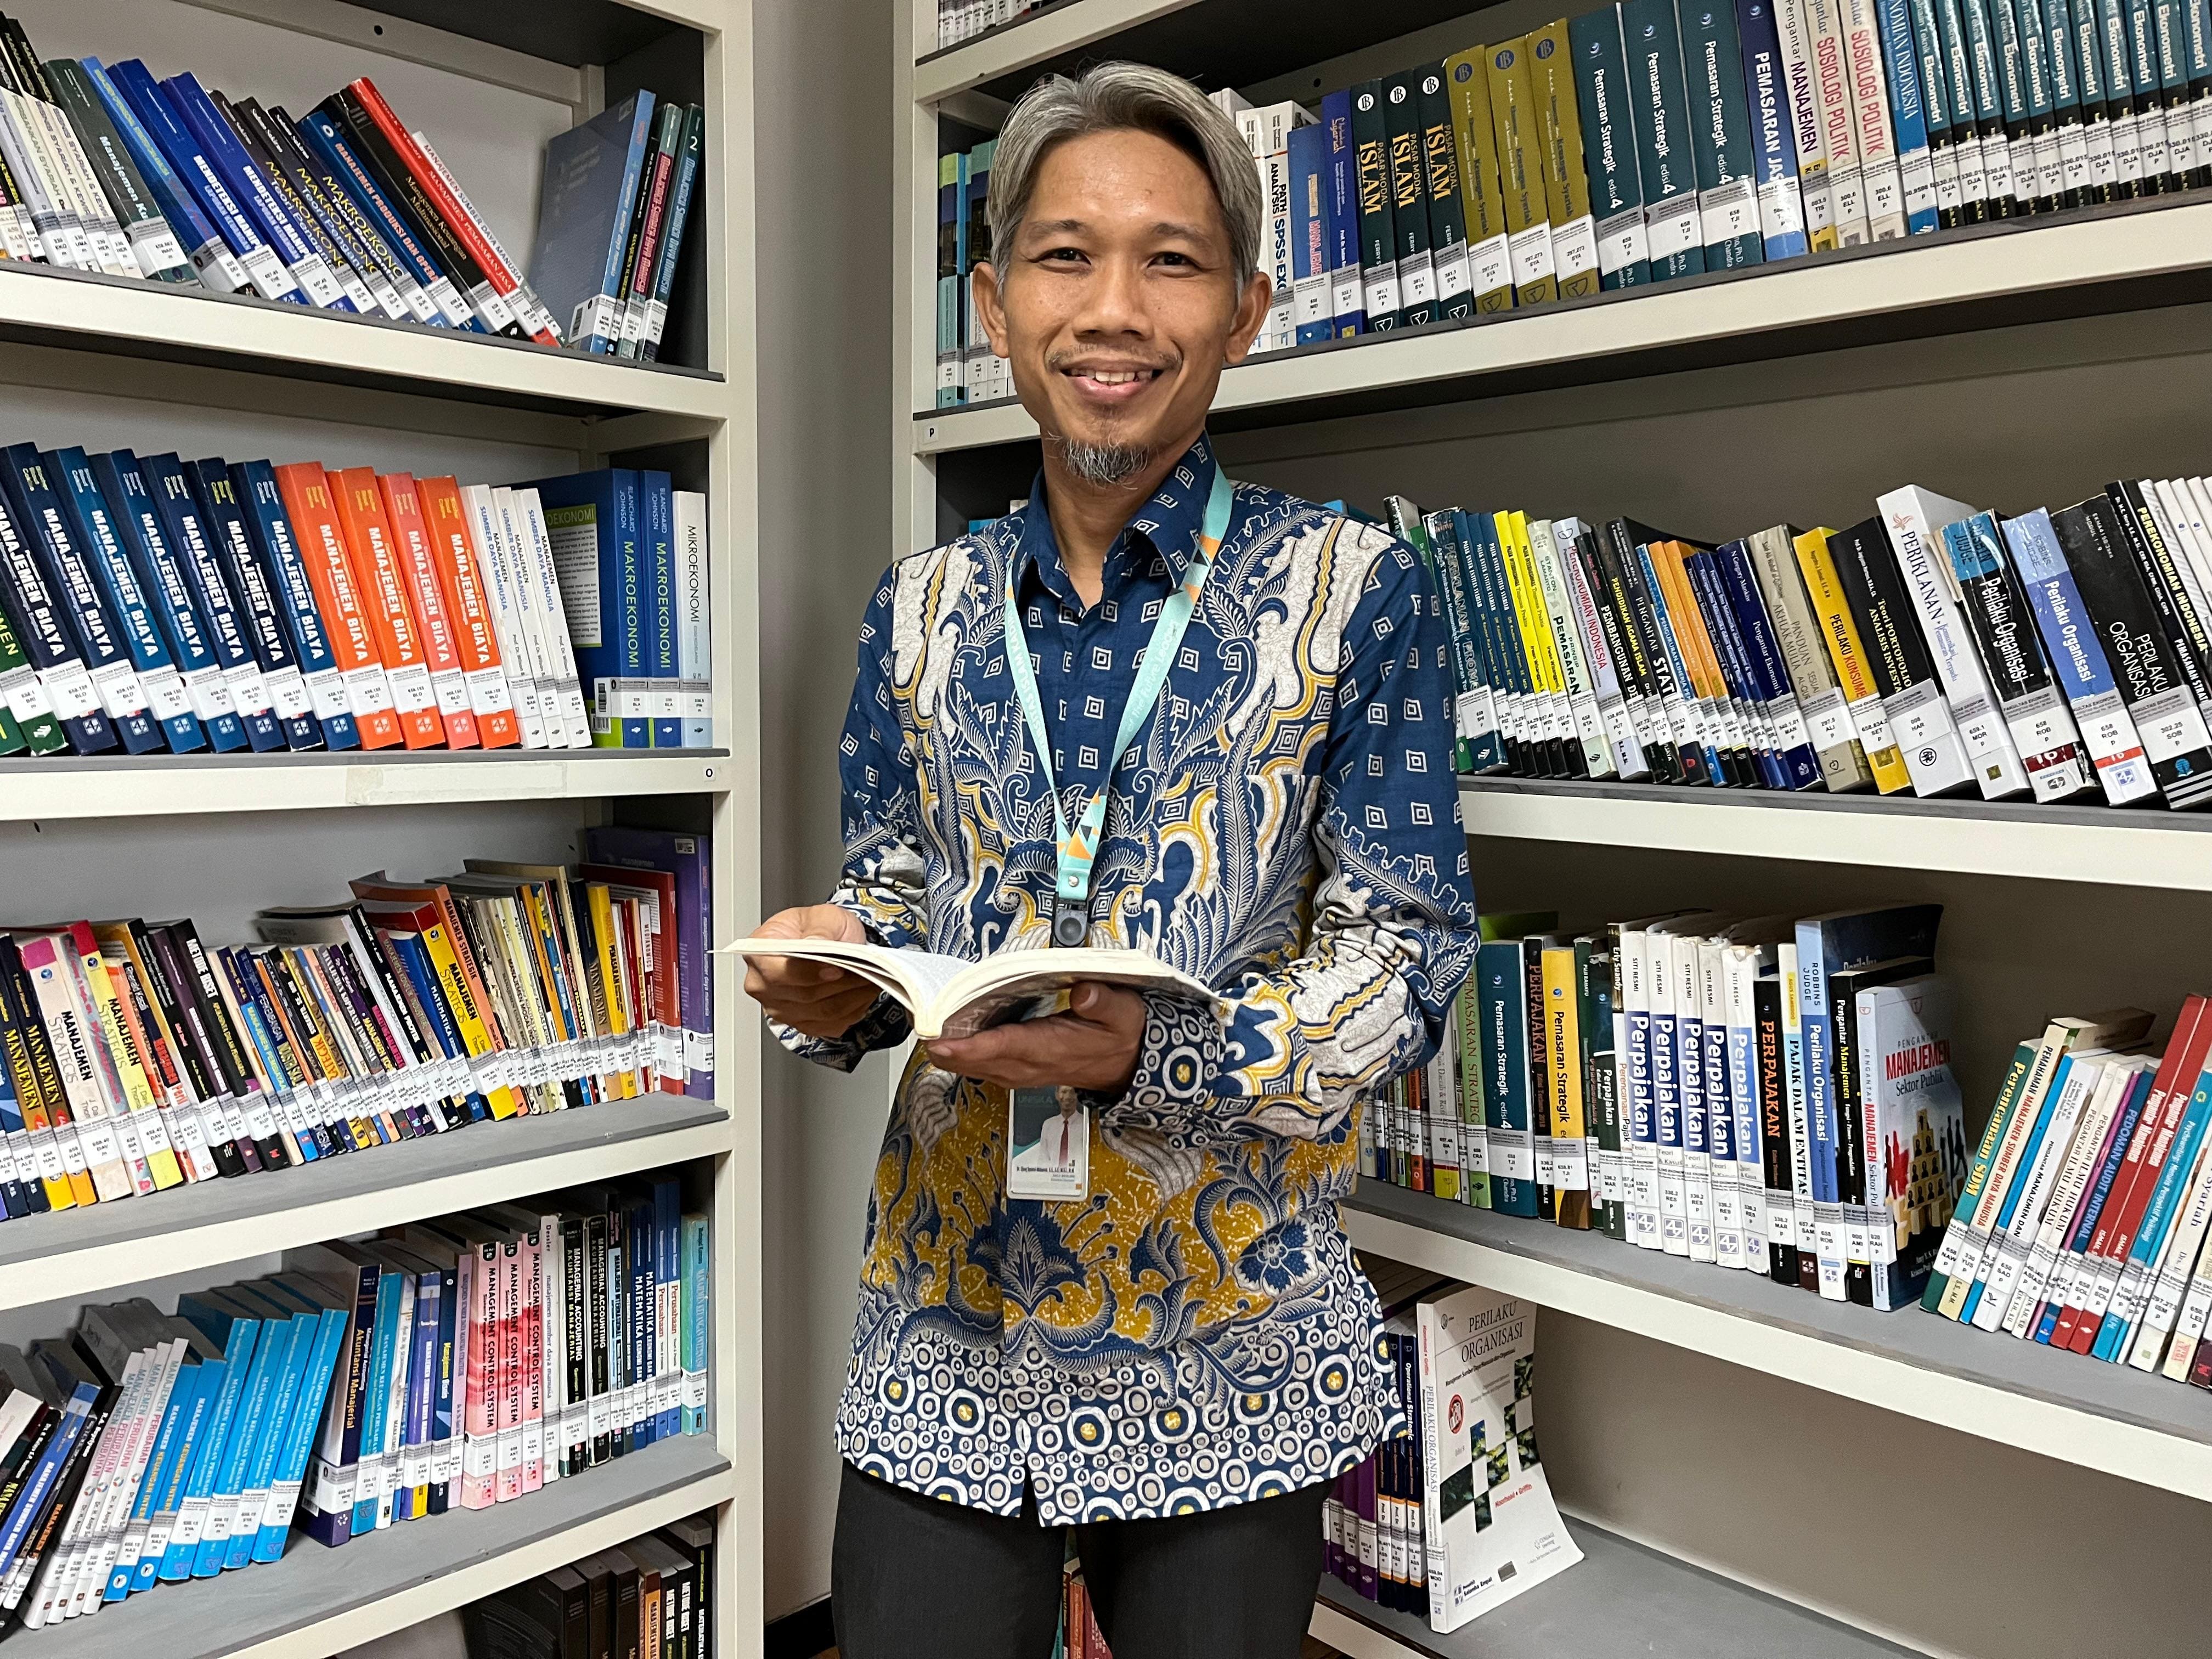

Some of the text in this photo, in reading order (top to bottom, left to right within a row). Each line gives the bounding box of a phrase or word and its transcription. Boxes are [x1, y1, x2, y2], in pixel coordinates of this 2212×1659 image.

[1594, 69, 1610, 125] Pemasaran
[1705, 41, 1719, 97] Pemasaran
[1712, 98, 1725, 148] Strategik
[1719, 174, 1734, 185] 4
[1755, 52, 1781, 153] PEMASARAN
[1817, 37, 1850, 161] SOSIOLOGI POLITIK
[1852, 29, 1884, 156] SOSIOLOGI POLITIK
[1923, 55, 1943, 124] Ekonometri
[1950, 46, 1970, 115] Ekonometri
[1975, 42, 1994, 111] Ekonometri
[690, 136, 698, 151] 2
[1426, 123, 1451, 201] ISLAM
[1601, 126, 1617, 174] Strategik
[1647, 52, 1662, 108] Pemasaran
[1655, 109, 1668, 159] Strategik
[1662, 184, 1676, 194] 4
[100, 136, 138, 202] Manajemen
[1271, 163, 1280, 215] ANALYSIS
[1360, 140, 1382, 216] ISLAM
[1392, 132, 1415, 208] ISLAM
[1610, 199, 1623, 209] 4
[458, 193, 483, 225] SUMBER
[481, 225, 496, 247] DAYA
[495, 247, 522, 281] MANUSIA
[1274, 219, 1285, 261] SPSS
[43, 509, 114, 657] MANAJEMEN BIAYA
[92, 510, 158, 657] MANAJEMEN BIAYA
[141, 513, 204, 658] MANAJEMEN BIAYA
[183, 516, 247, 659] MANAJEMEN BIAYA
[479, 506, 508, 610] SUMBER DAYA MANUSIA
[493, 533, 509, 583] MANAJEMEN
[501, 508, 528, 611] SUMBER DAYA MANUSIA
[514, 534, 529, 583] MANAJEMEN
[528, 510, 554, 612] SUMBER DAYA MANUSIA
[541, 535, 555, 584] MANAJEMEN
[687, 526, 700, 622] MIKROEKONOMI
[1901, 531, 1945, 622] PERIKLANAN
[2137, 507, 2209, 653] PEREKONOMIAN INDONESIA
[624, 541, 639, 668] MAKROEKONOMI
[656, 543, 670, 668] MAKROEKONOMI
[1601, 605, 1633, 682] PEMBANGUNAN
[1791, 621, 1811, 666] PANDUAN
[1829, 614, 1850, 657] PERILAKU
[1980, 577, 2034, 683] Perilaku Organisasi
[2045, 581, 2096, 682] Perilaku Organisasi
[1884, 622, 1912, 687] PORTOFOLIO
[2109, 622, 2152, 699] ORGANISASI
[2135, 634, 2170, 693] PERILAKU
[1530, 965, 1546, 1063] PERPAJAKAN
[1803, 967, 1812, 1001] JUDGE
[1812, 963, 1821, 1006] ROBBINS
[4, 1029, 41, 1110] MANAJEMEN
[26, 1025, 62, 1104] MANAJEMEN
[48, 1016, 78, 1084] STRATEGIS
[61, 1011, 93, 1081] MANAJEMEN
[1554, 1012, 1571, 1122] Pemasaran Strategik
[1629, 1017, 1652, 1136] Perpajakan
[1652, 1020, 1678, 1141] Perpajakan
[1679, 1023, 1704, 1148] Perpajakan
[1762, 1020, 1780, 1139] PERPAJAKAN
[1810, 1024, 1826, 1142] Perilaku Organisasi
[1837, 1000, 1849, 1099] Pengantar Manajemen
[1886, 1040, 1950, 1081] MANAJEMEN
[1896, 1071, 1944, 1097] Sektor Publik
[1605, 1069, 1615, 1125] Perpajakan
[1619, 1063, 1630, 1118] Perencanaan
[1706, 1030, 1733, 1155] Perpajakan
[1789, 1039, 1808, 1195] PAJAK DALAM ENTITAS
[1966, 1062, 2026, 1197] Perencanaan SDM
[1864, 1104, 1877, 1162] MANAJEMEN
[1976, 1046, 2053, 1227] PEMAHAMAN MANAJEMEN SUMBER DAYA MANUSIA
[635, 1276, 644, 1339] MATEMATIKA
[1461, 1322, 1523, 1362] ORGANISASI
[1468, 1301, 1517, 1333] PERILAKU
[347, 1329, 364, 1429] Akuntansi Manajerial
[1426, 1385, 1438, 1493] PERILAKU ORGANISASI
